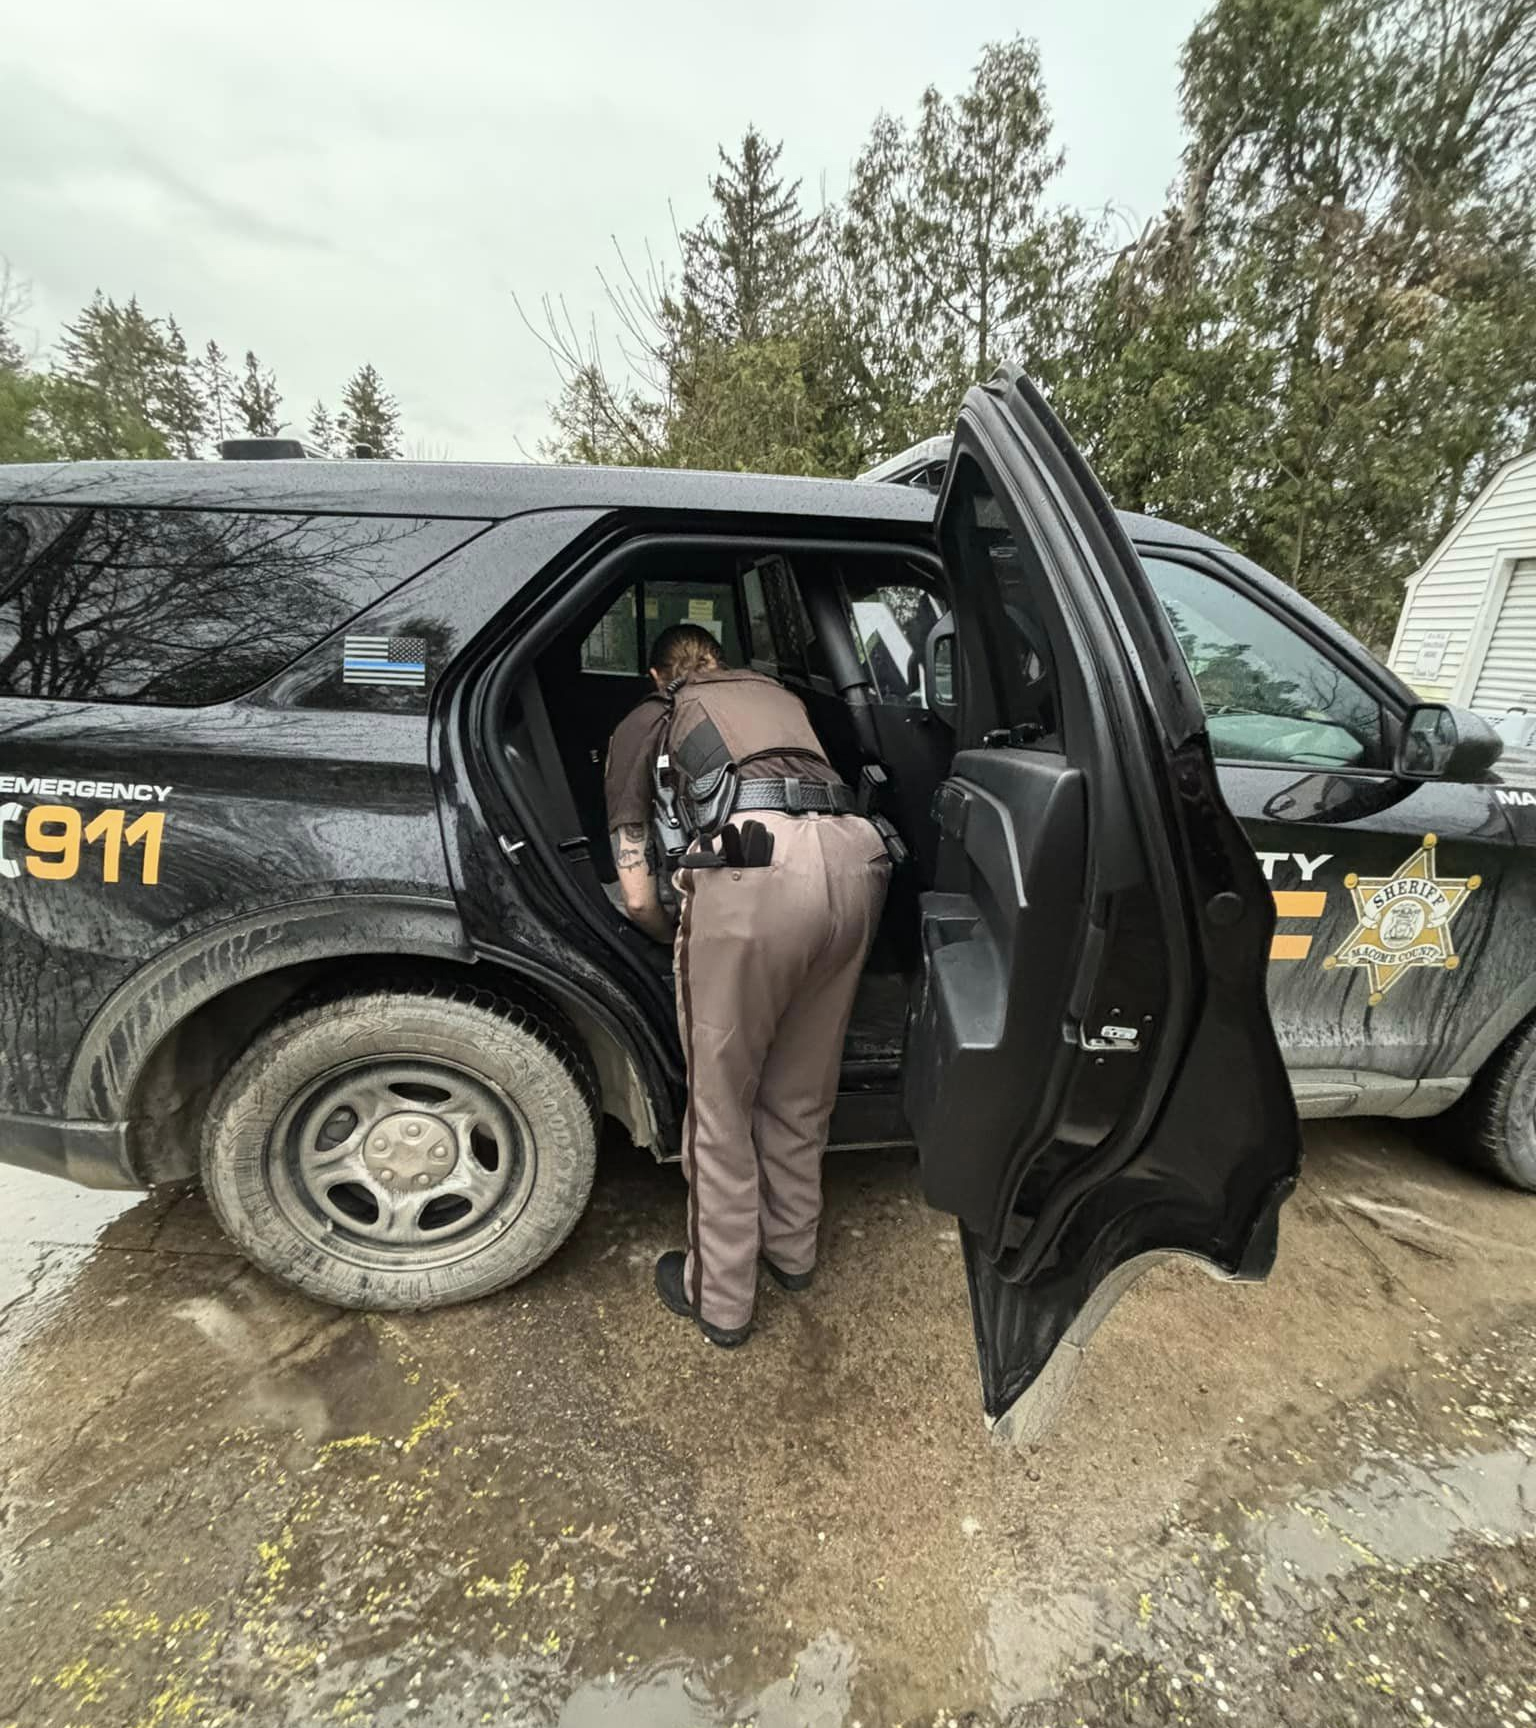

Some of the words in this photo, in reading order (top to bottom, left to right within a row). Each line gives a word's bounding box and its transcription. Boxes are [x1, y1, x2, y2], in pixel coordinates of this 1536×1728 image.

[0, 776, 173, 802] EMERGENCY
[1495, 790, 1536, 806] MA
[25, 804, 166, 885] 911
[1254, 851, 1335, 881] TY
[1373, 880, 1446, 909] SHERIFF
